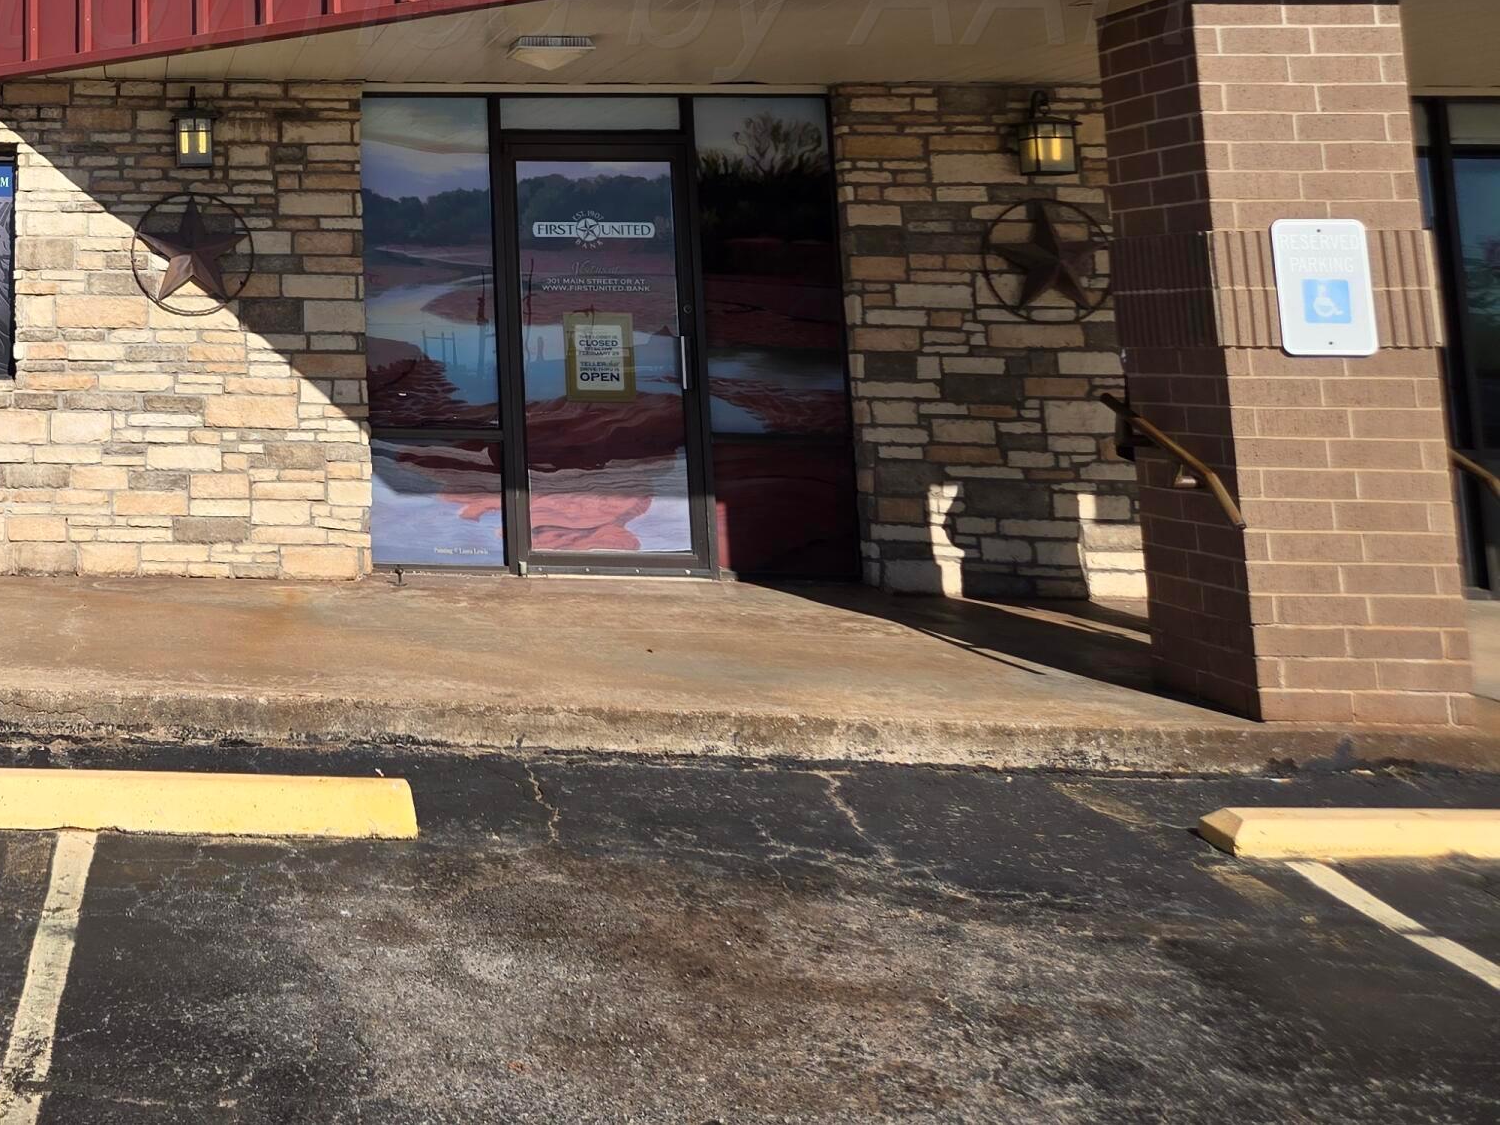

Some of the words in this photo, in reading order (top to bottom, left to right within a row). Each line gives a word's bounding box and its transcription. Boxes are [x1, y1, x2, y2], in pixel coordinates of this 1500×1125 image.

[537, 224, 575, 235] FIRST
[601, 224, 651, 235] UNITED
[1278, 234, 1359, 251] RESERVED
[1289, 257, 1354, 273] PARKING
[579, 339, 618, 347] CLOSED
[580, 372, 620, 382] OPEN
